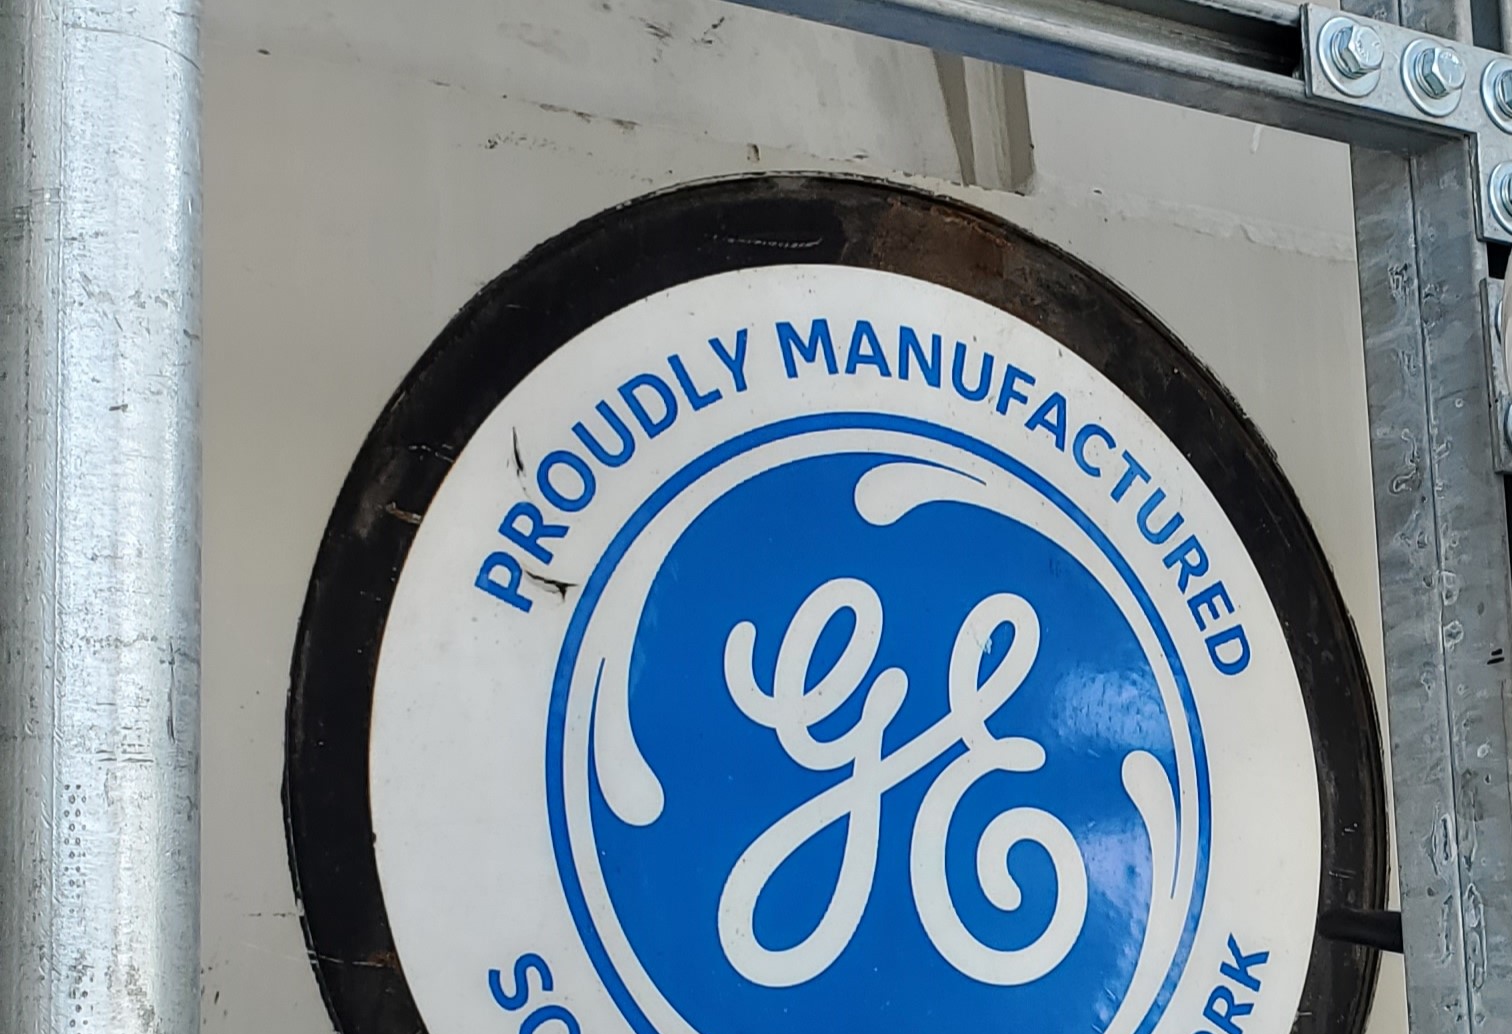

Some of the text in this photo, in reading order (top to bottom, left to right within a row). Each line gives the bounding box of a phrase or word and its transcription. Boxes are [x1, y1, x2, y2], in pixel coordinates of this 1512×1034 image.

[474, 317, 1251, 676] PROUDLY MANUFACTURED
[716, 576, 1088, 988] GE
